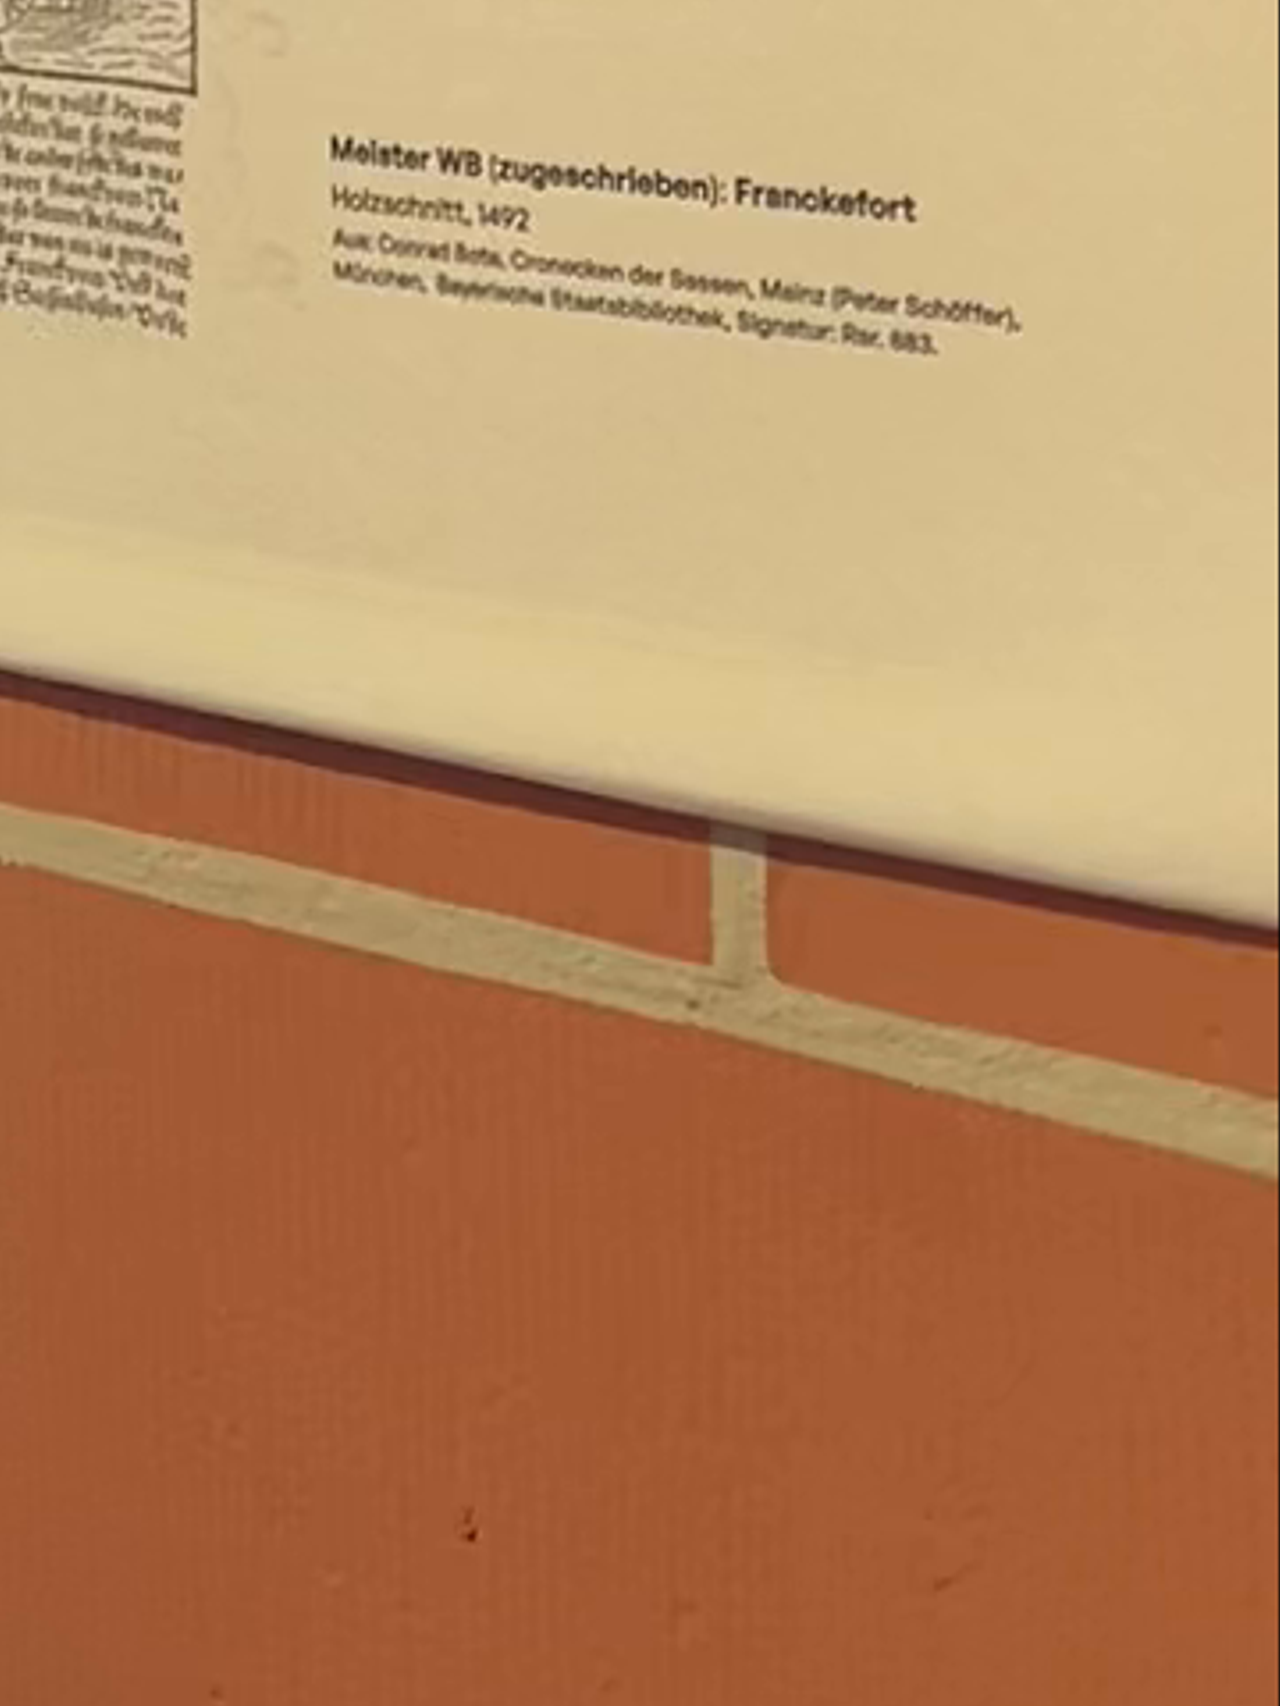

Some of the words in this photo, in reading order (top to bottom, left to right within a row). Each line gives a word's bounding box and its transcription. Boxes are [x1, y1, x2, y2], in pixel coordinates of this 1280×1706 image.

[330, 134, 431, 171] Meister
[435, 147, 483, 178] WB
[489, 154, 727, 208] (zugeschrieben):
[734, 176, 917, 223] Franckefort
[331, 184, 473, 228] Holzschnitt,
[628, 264, 664, 286] der
